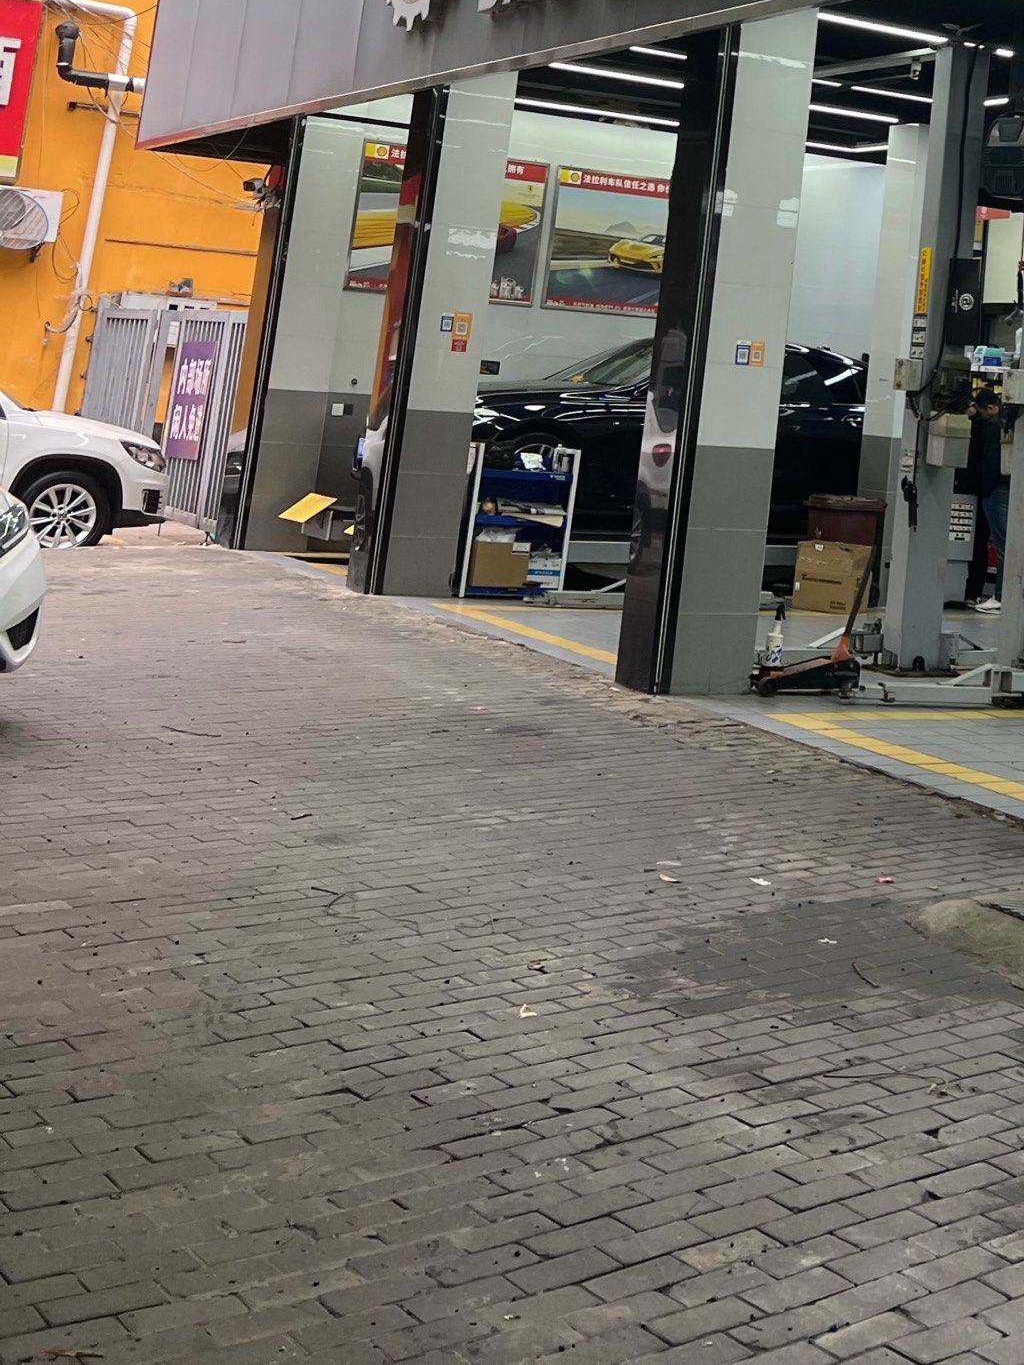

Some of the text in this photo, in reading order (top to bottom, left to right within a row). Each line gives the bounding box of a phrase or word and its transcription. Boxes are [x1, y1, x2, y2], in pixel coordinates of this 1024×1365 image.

[583, 173, 656, 192] 法拉利车队信任之选
[177, 358, 212, 395] 内部场所
